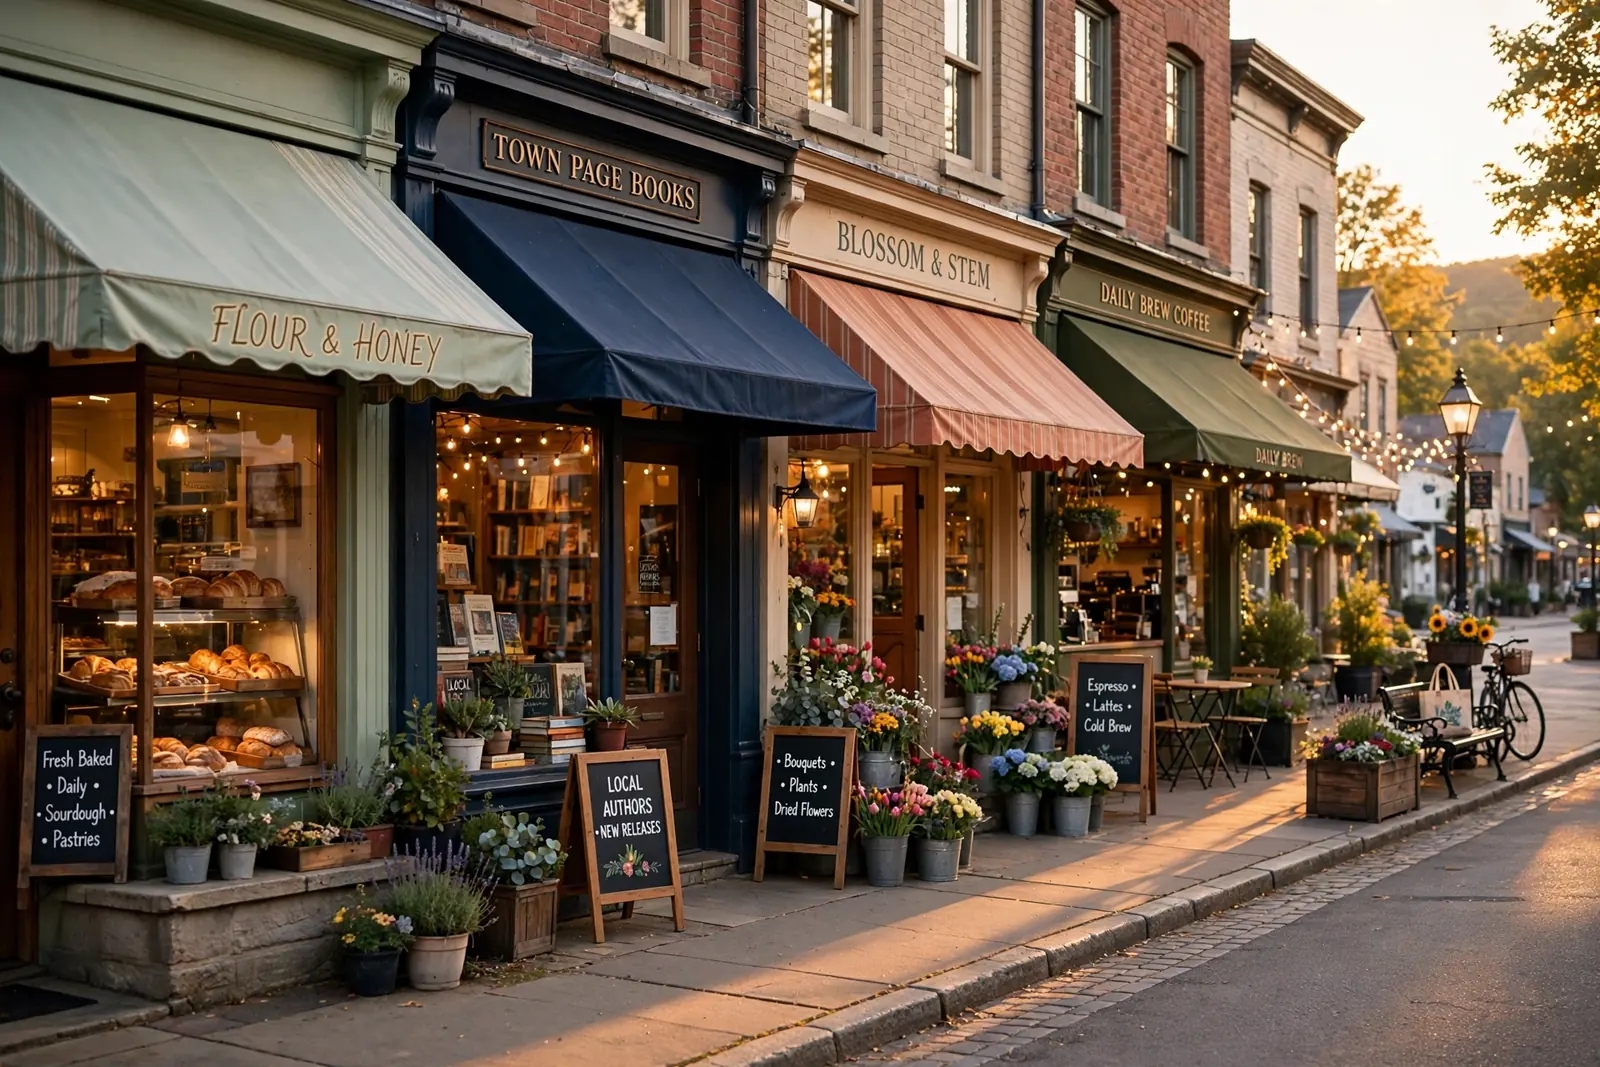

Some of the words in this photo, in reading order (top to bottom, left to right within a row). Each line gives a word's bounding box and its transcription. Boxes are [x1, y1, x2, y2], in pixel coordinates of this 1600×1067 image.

[493, 133, 562, 174] TOWN
[570, 154, 623, 191] PAGE
[630, 171, 695, 210] BOOKS
[837, 220, 925, 273] BLOSSOM
[931, 248, 943, 277] &
[948, 253, 991, 290] STEM
[1101, 282, 1135, 310] DAILY
[1140, 294, 1171, 320] BREW
[1173, 305, 1210, 333] COFFEE
[212, 303, 313, 358] FLOUR
[322, 324, 340, 354] &
[353, 320, 442, 373] HONEY
[1255, 447, 1280, 467] DAILY
[1087, 678, 1129, 696] Espresso
[1093, 698, 1123, 712] Lattes
[1084, 718, 1105, 732] Cold
[1108, 718, 1132, 733] Brew
[43, 749, 74, 769] Fresh
[78, 748, 113, 767] Baked
[784, 753, 827, 774] Bouquets
[57, 776, 87, 799] Daily
[607, 775, 644, 793] LOCAL
[789, 777, 818, 793] Plants
[45, 802, 106, 826] Sourdough
[603, 797, 653, 818] AUTHORS
[774, 801, 798, 816] Dried
[800, 801, 834, 818] Flowers
[53, 829, 101, 848] Pastries
[600, 823, 619, 839] NEW
[621, 820, 661, 837] RELEASES
